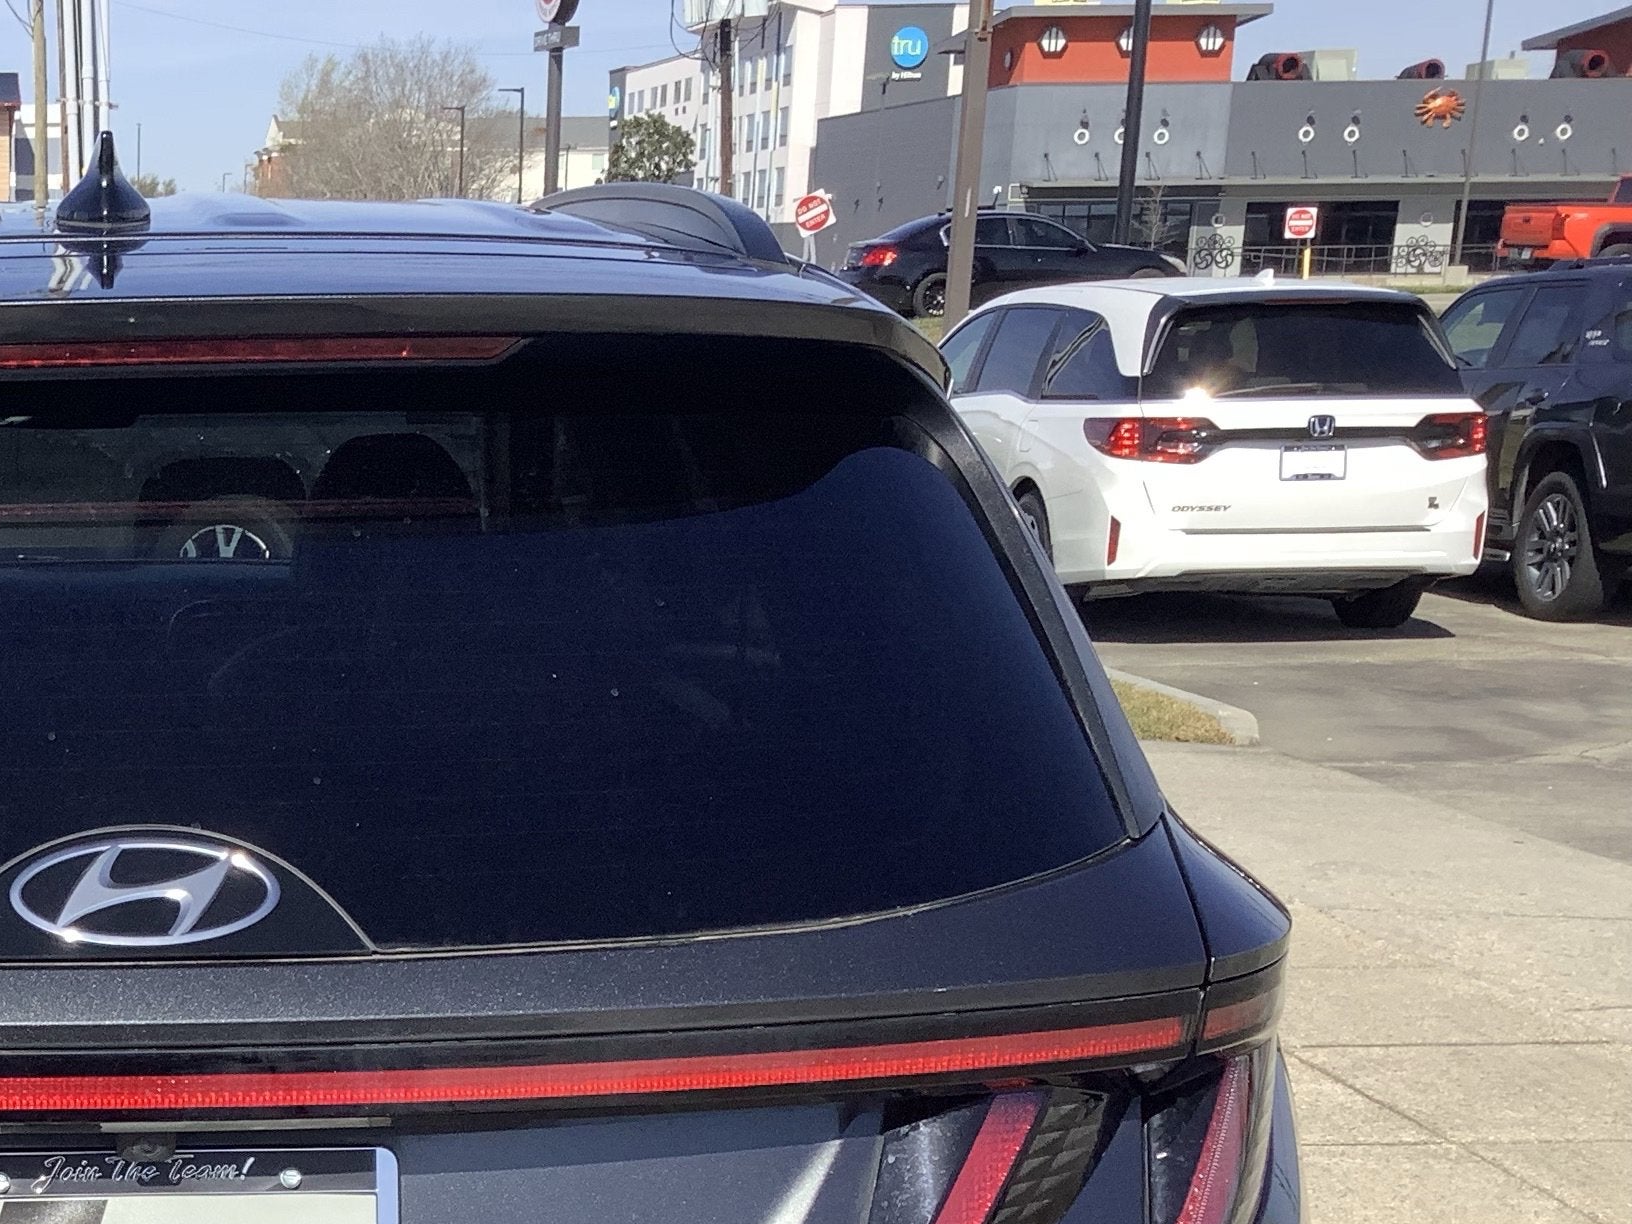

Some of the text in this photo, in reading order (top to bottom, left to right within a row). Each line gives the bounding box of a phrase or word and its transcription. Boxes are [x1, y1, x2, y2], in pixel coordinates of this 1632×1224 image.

[891, 35, 922, 56] tru
[808, 197, 822, 209] NOT
[805, 213, 826, 228] ENTER
[1171, 505, 1232, 513] ODYSSEY
[31, 1154, 256, 1194] Join The Team!
